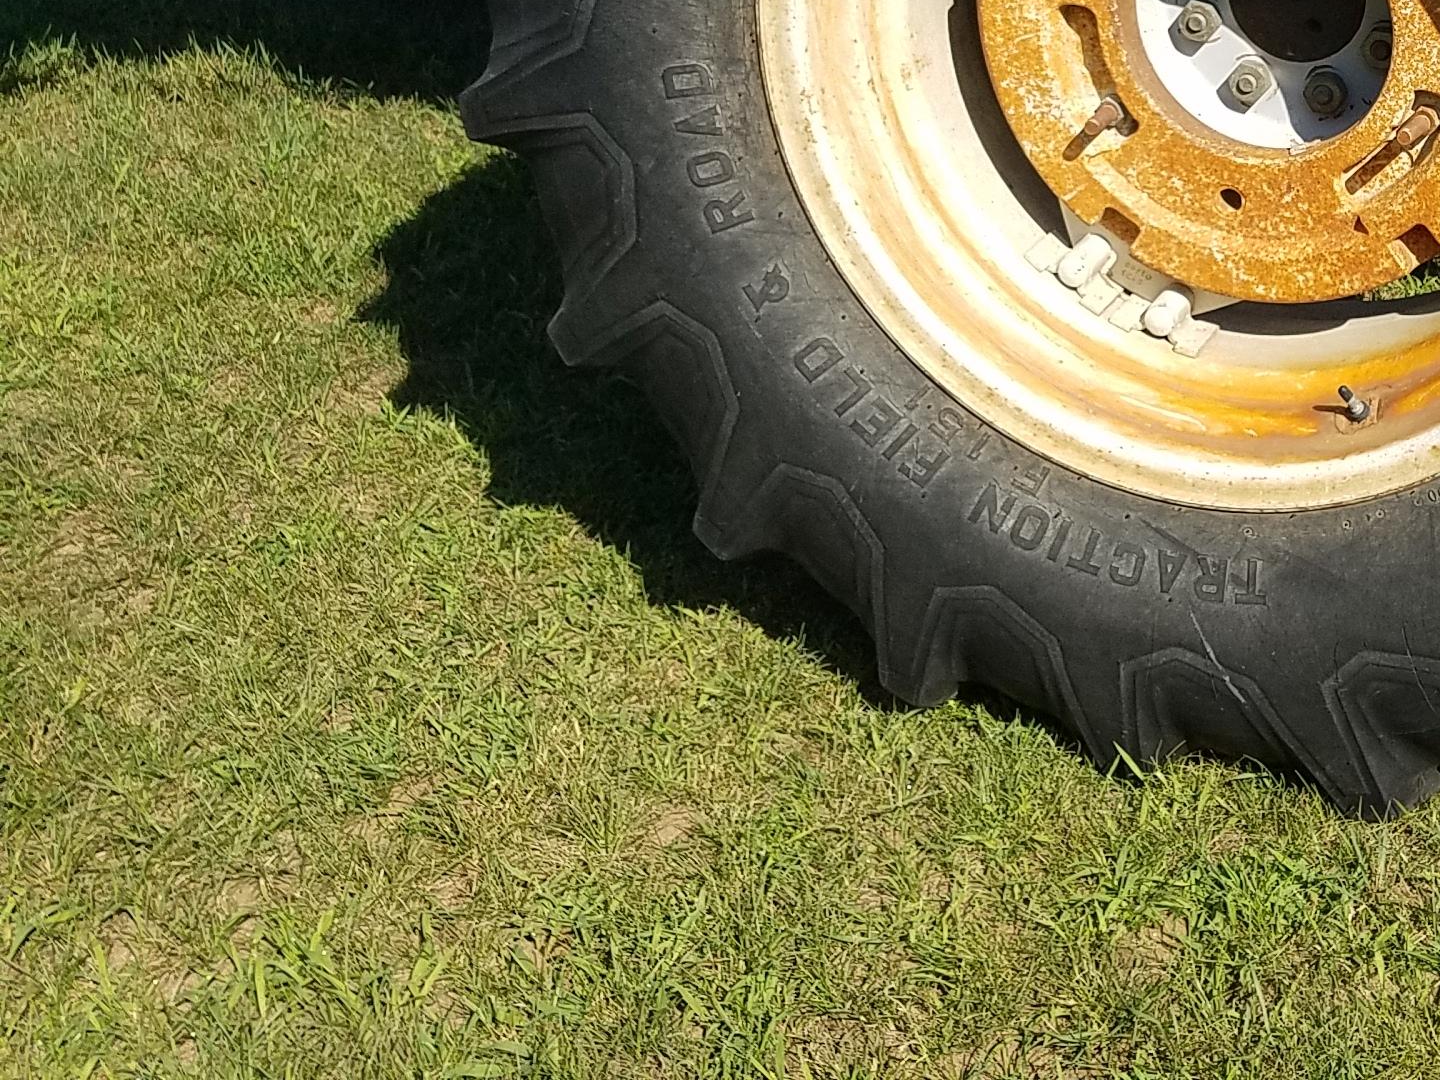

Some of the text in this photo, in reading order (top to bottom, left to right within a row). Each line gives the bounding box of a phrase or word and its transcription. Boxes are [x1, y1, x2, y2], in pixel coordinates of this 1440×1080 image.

[662, 60, 1269, 606] TRACTION FIELD & ROAD
